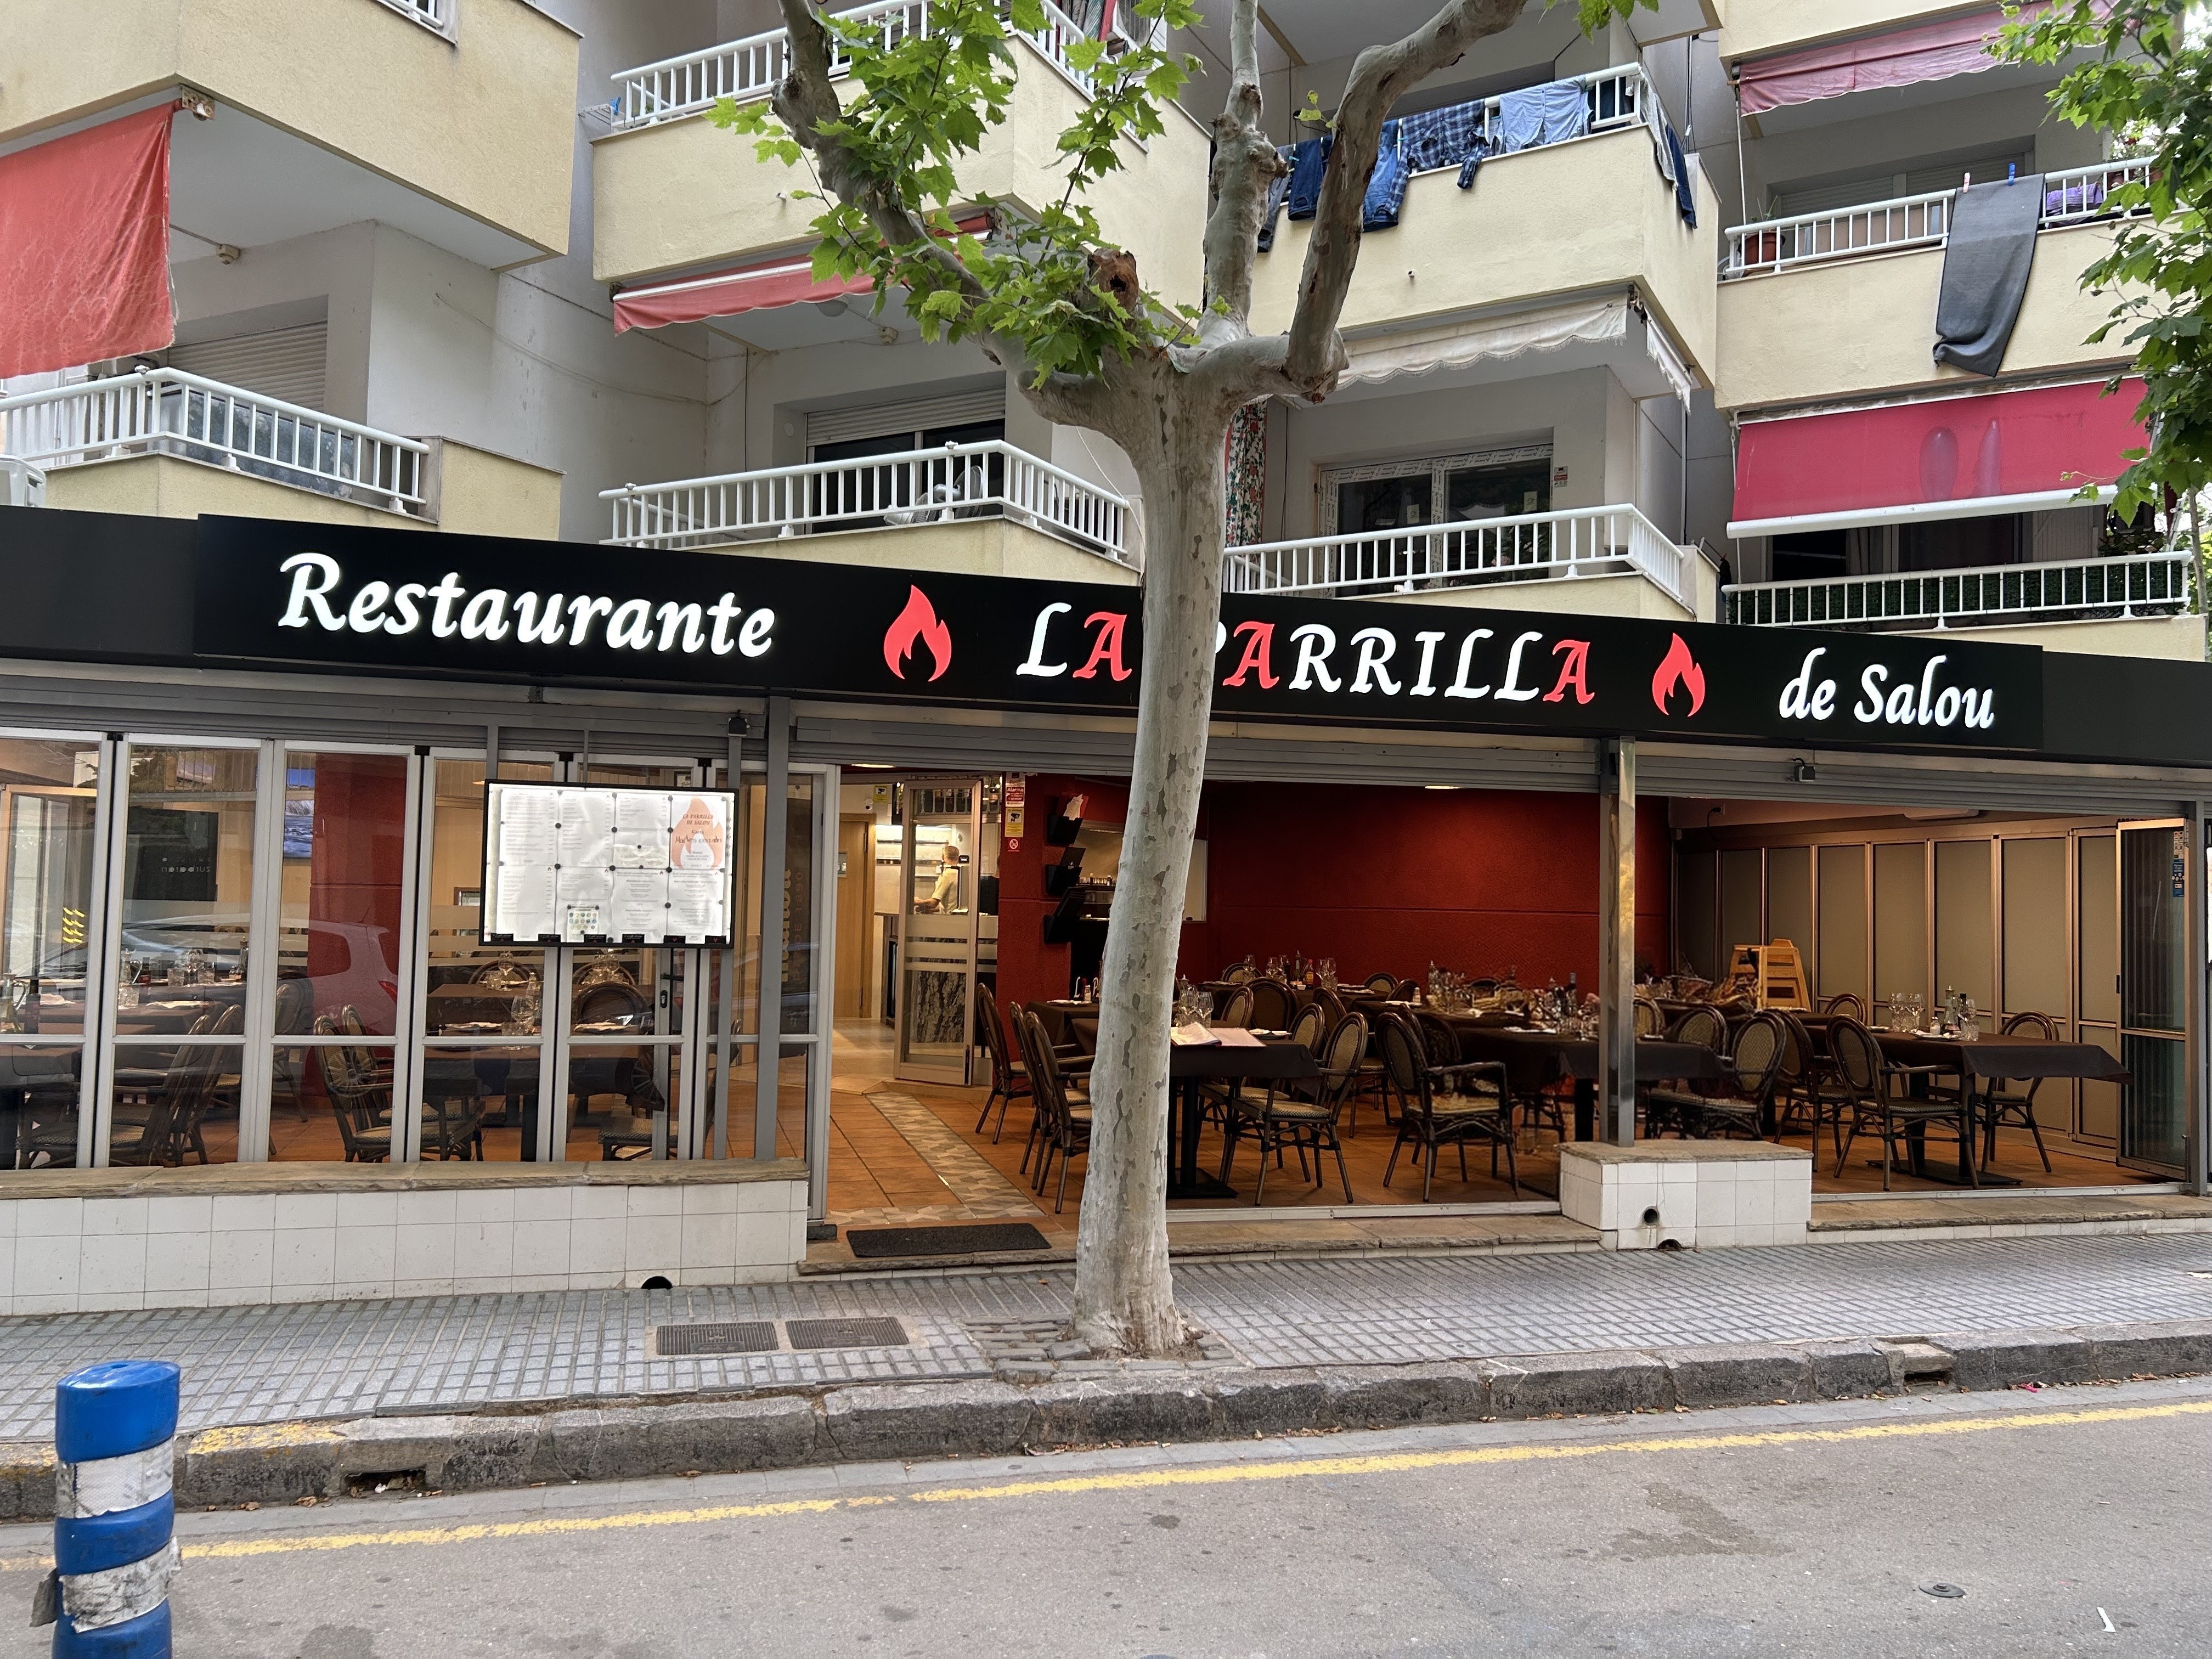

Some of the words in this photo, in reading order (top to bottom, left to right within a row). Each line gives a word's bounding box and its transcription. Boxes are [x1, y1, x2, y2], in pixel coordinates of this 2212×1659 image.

[278, 552, 775, 657] Restaurante
[1016, 602, 1132, 681] LA
[1779, 647, 1836, 720] de
[1854, 654, 1995, 729] Salou
